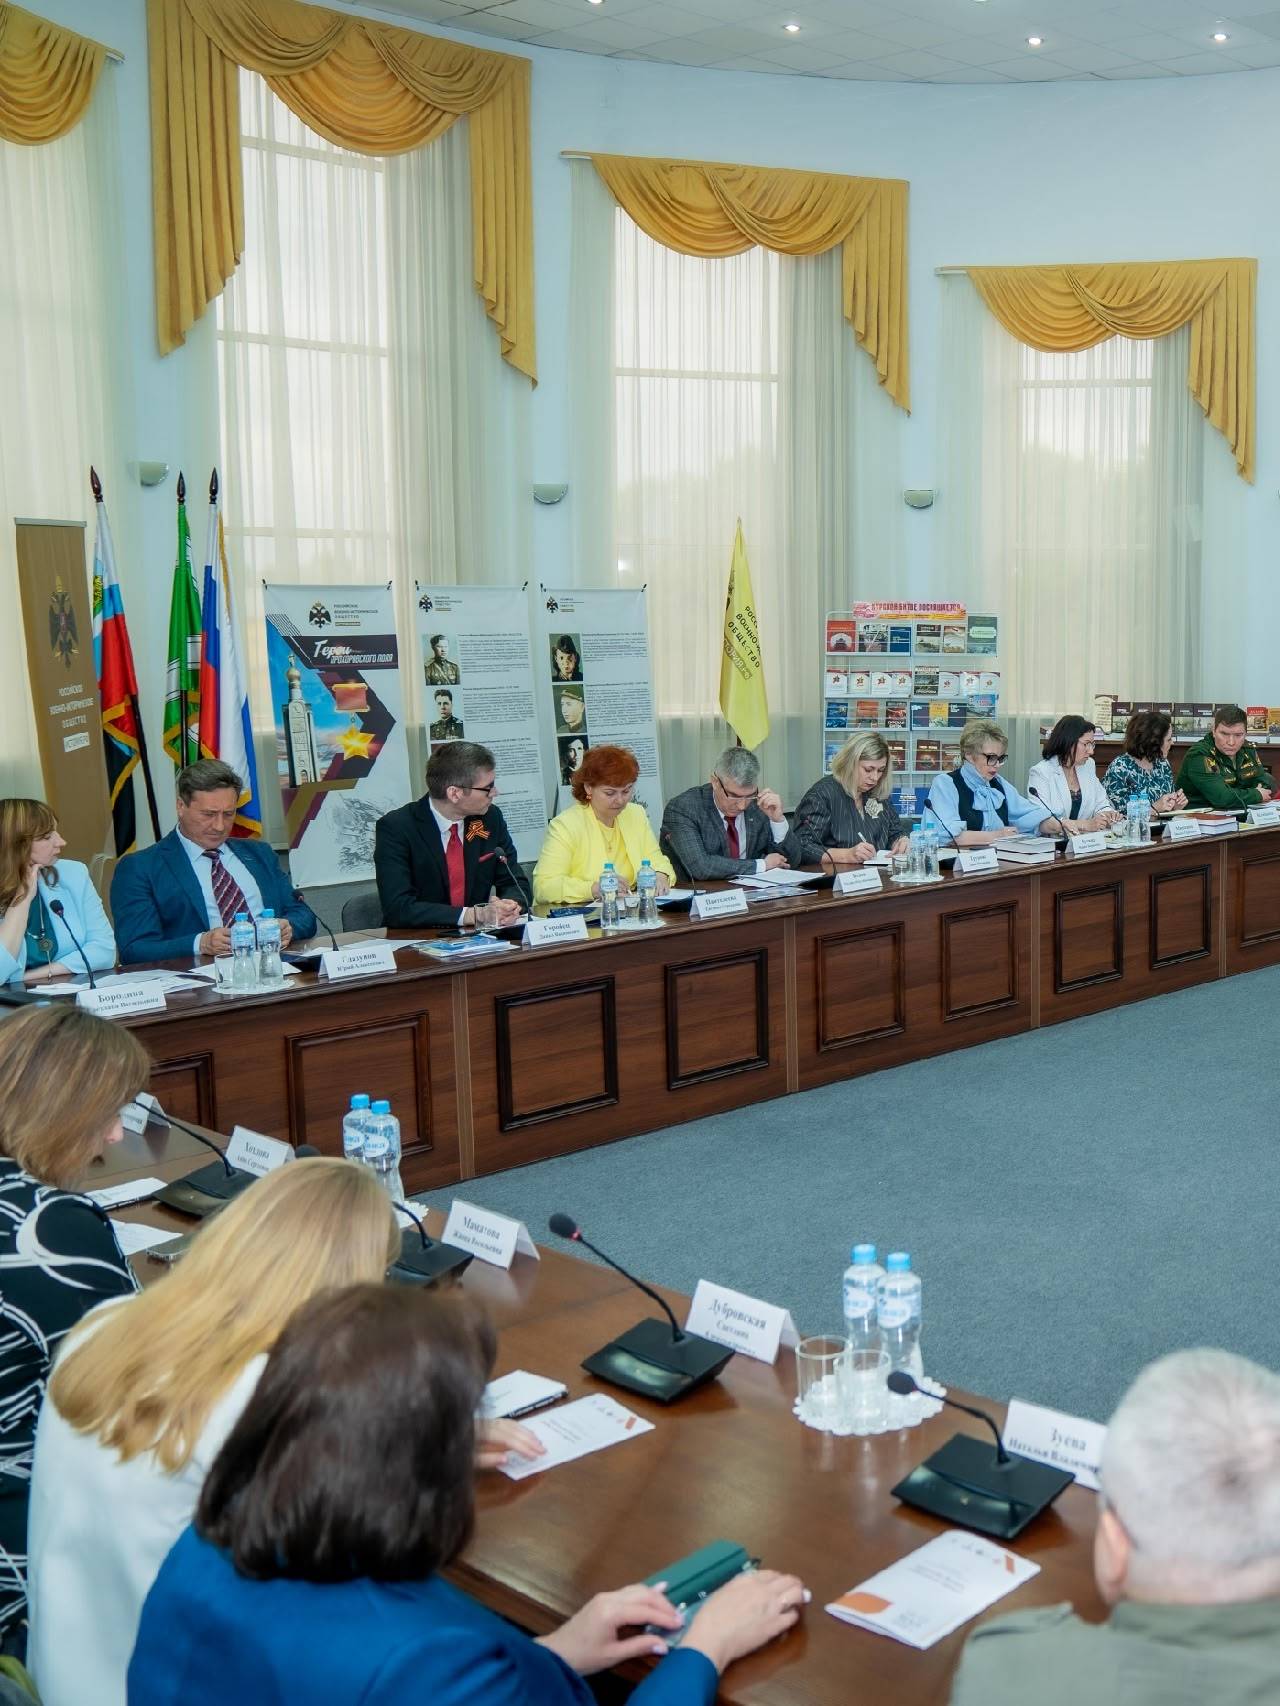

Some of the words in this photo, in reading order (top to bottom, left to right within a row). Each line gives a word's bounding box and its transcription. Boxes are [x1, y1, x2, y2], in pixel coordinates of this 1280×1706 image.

[313, 639, 352, 659] Герои
[727, 621, 761, 668] ОБЩЕСТВО
[97, 990, 144, 1003] Бородина
[463, 1215, 501, 1240] Маматова
[708, 1299, 768, 1331] Дубровская
[1009, 1437, 1048, 1458] Наталья
[1051, 1427, 1087, 1451] Зуева
